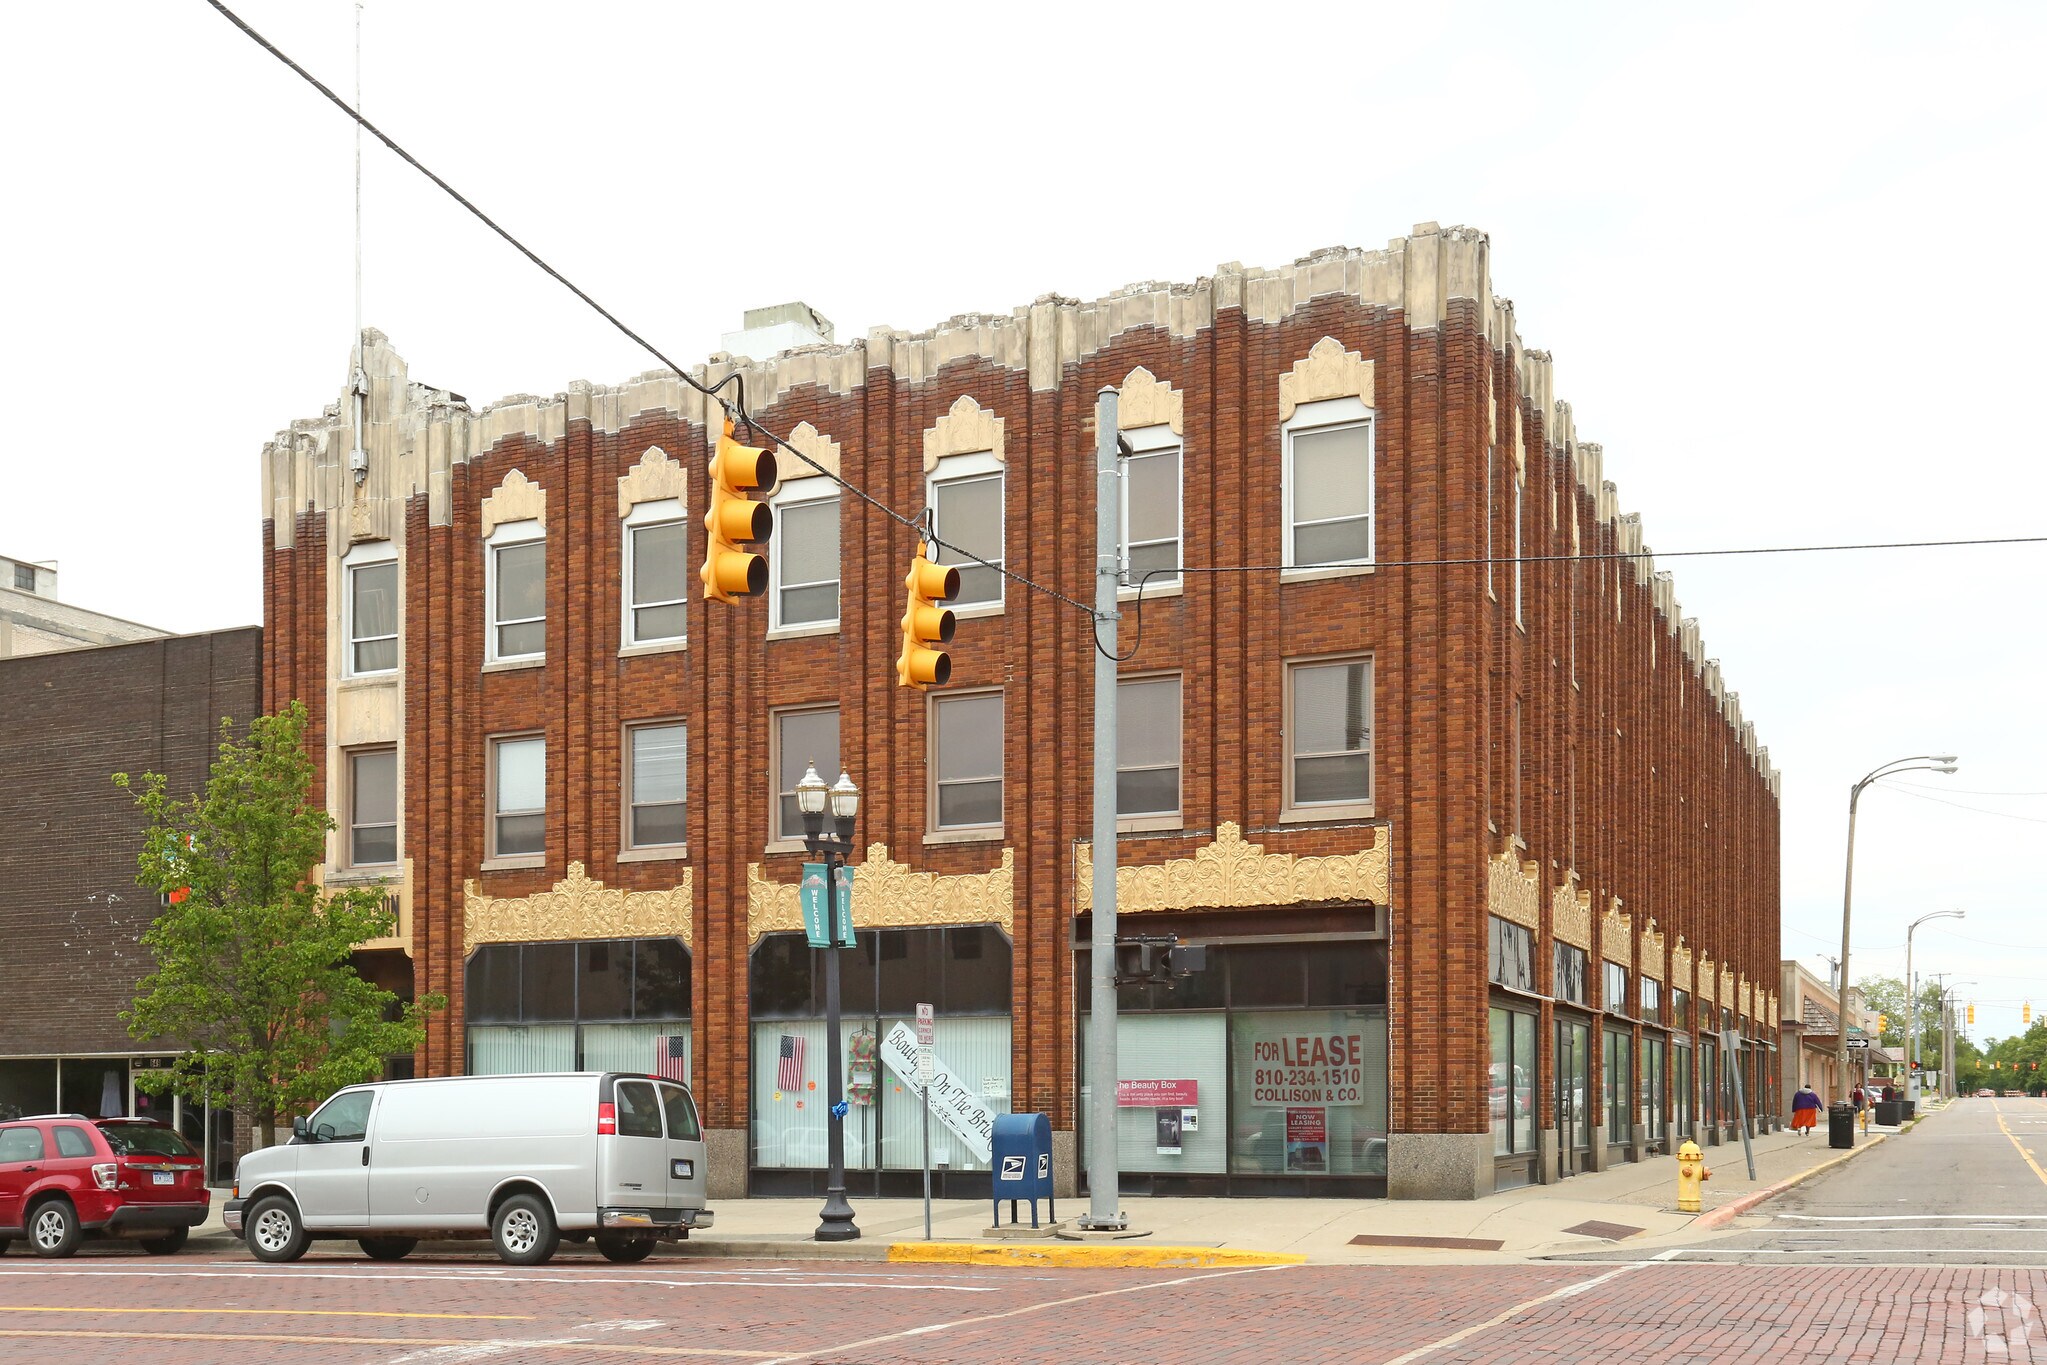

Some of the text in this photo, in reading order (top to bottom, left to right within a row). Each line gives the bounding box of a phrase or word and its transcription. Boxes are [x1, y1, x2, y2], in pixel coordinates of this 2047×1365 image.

[811, 889, 820, 938] WELCOME
[921, 1007, 929, 1016] NO
[1255, 1035, 1361, 1067] FOR LEASE
[1131, 1080, 1159, 1090] Beauty
[1161, 1080, 1177, 1089] Box
[1255, 1068, 1360, 1086] 810-234-1510
[933, 1072, 951, 1095] On
[948, 1088, 972, 1115] The
[1255, 1087, 1360, 1102] COLLISON & CO.
